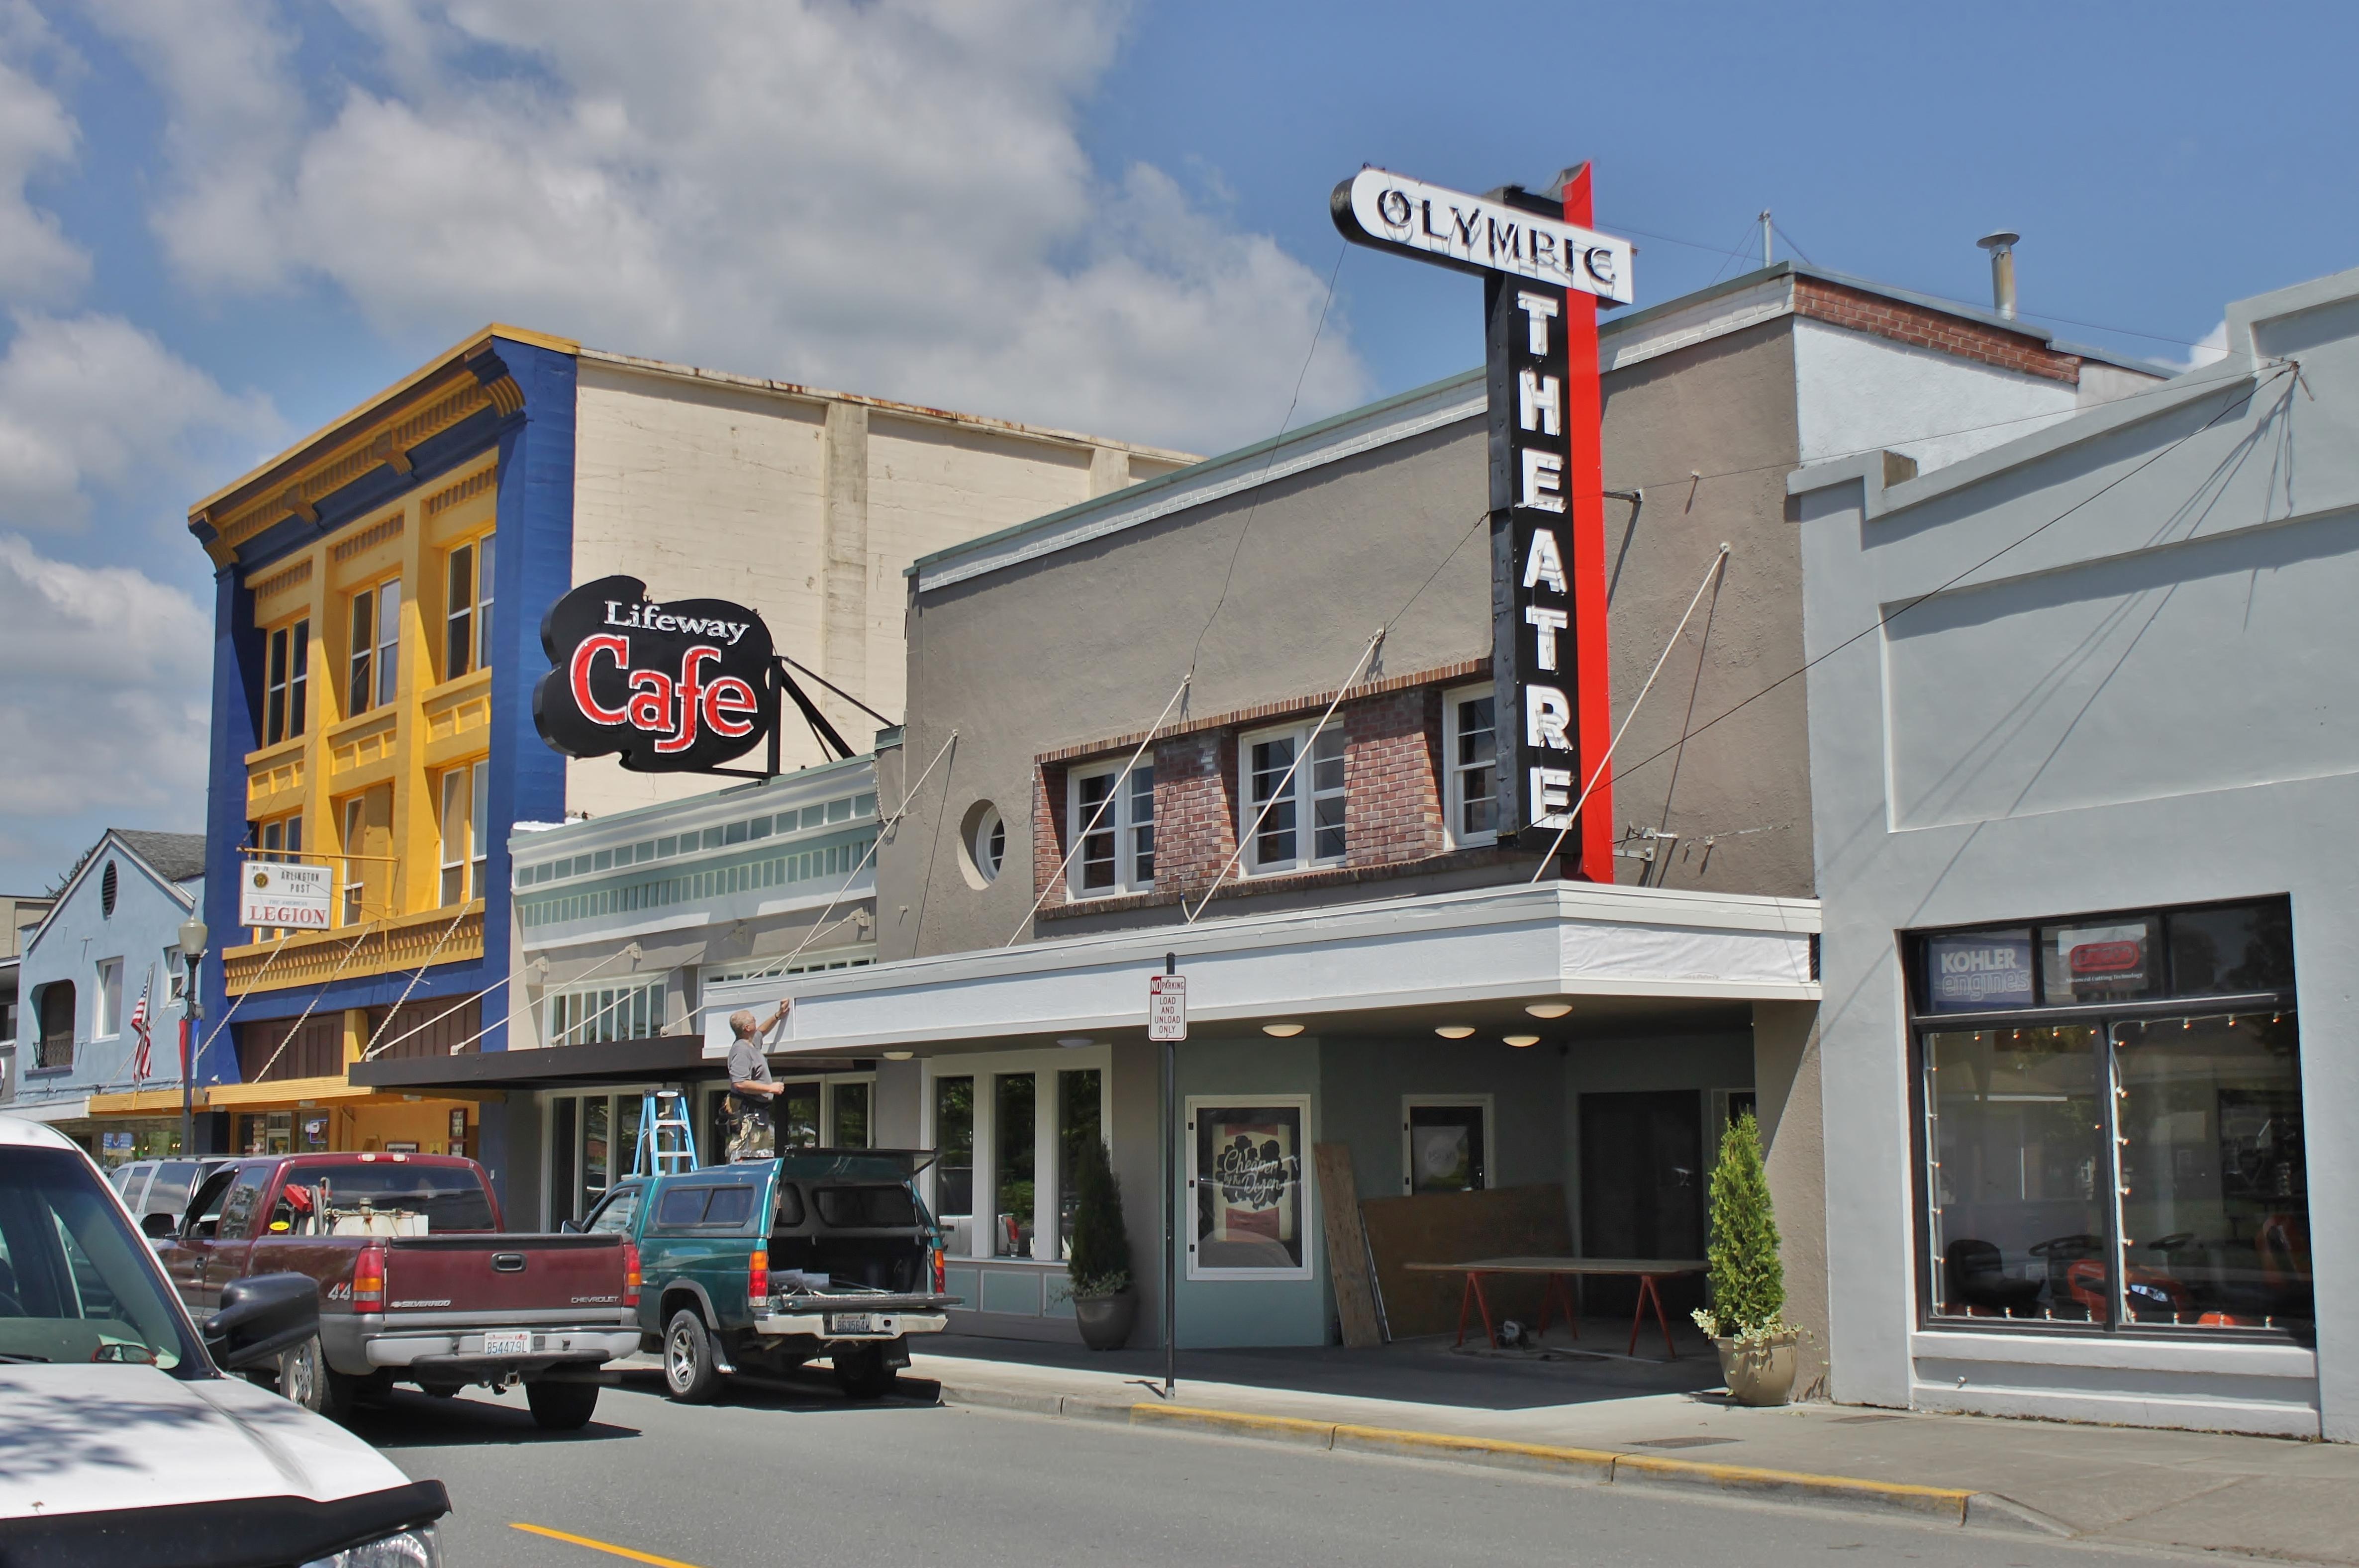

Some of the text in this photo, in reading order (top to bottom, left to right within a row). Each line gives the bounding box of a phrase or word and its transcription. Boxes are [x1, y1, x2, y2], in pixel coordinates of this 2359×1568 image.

[1377, 190, 1616, 285] OLYMPIC
[1517, 290, 1573, 831] THEATRE
[603, 600, 750, 646] Lifeway
[570, 633, 758, 753] Cafe
[281, 871, 319, 882] ARLINGTON
[291, 883, 310, 893] POST
[250, 905, 326, 924] LEGION
[1941, 948, 2017, 974] KOHLER
[1151, 980, 1161, 992] NO
[1942, 971, 2030, 1001] engines
[1224, 1148, 1278, 1176] Cheaper
[1241, 1173, 1281, 1203] Dozen
[488, 1341, 527, 1354] B54479L
